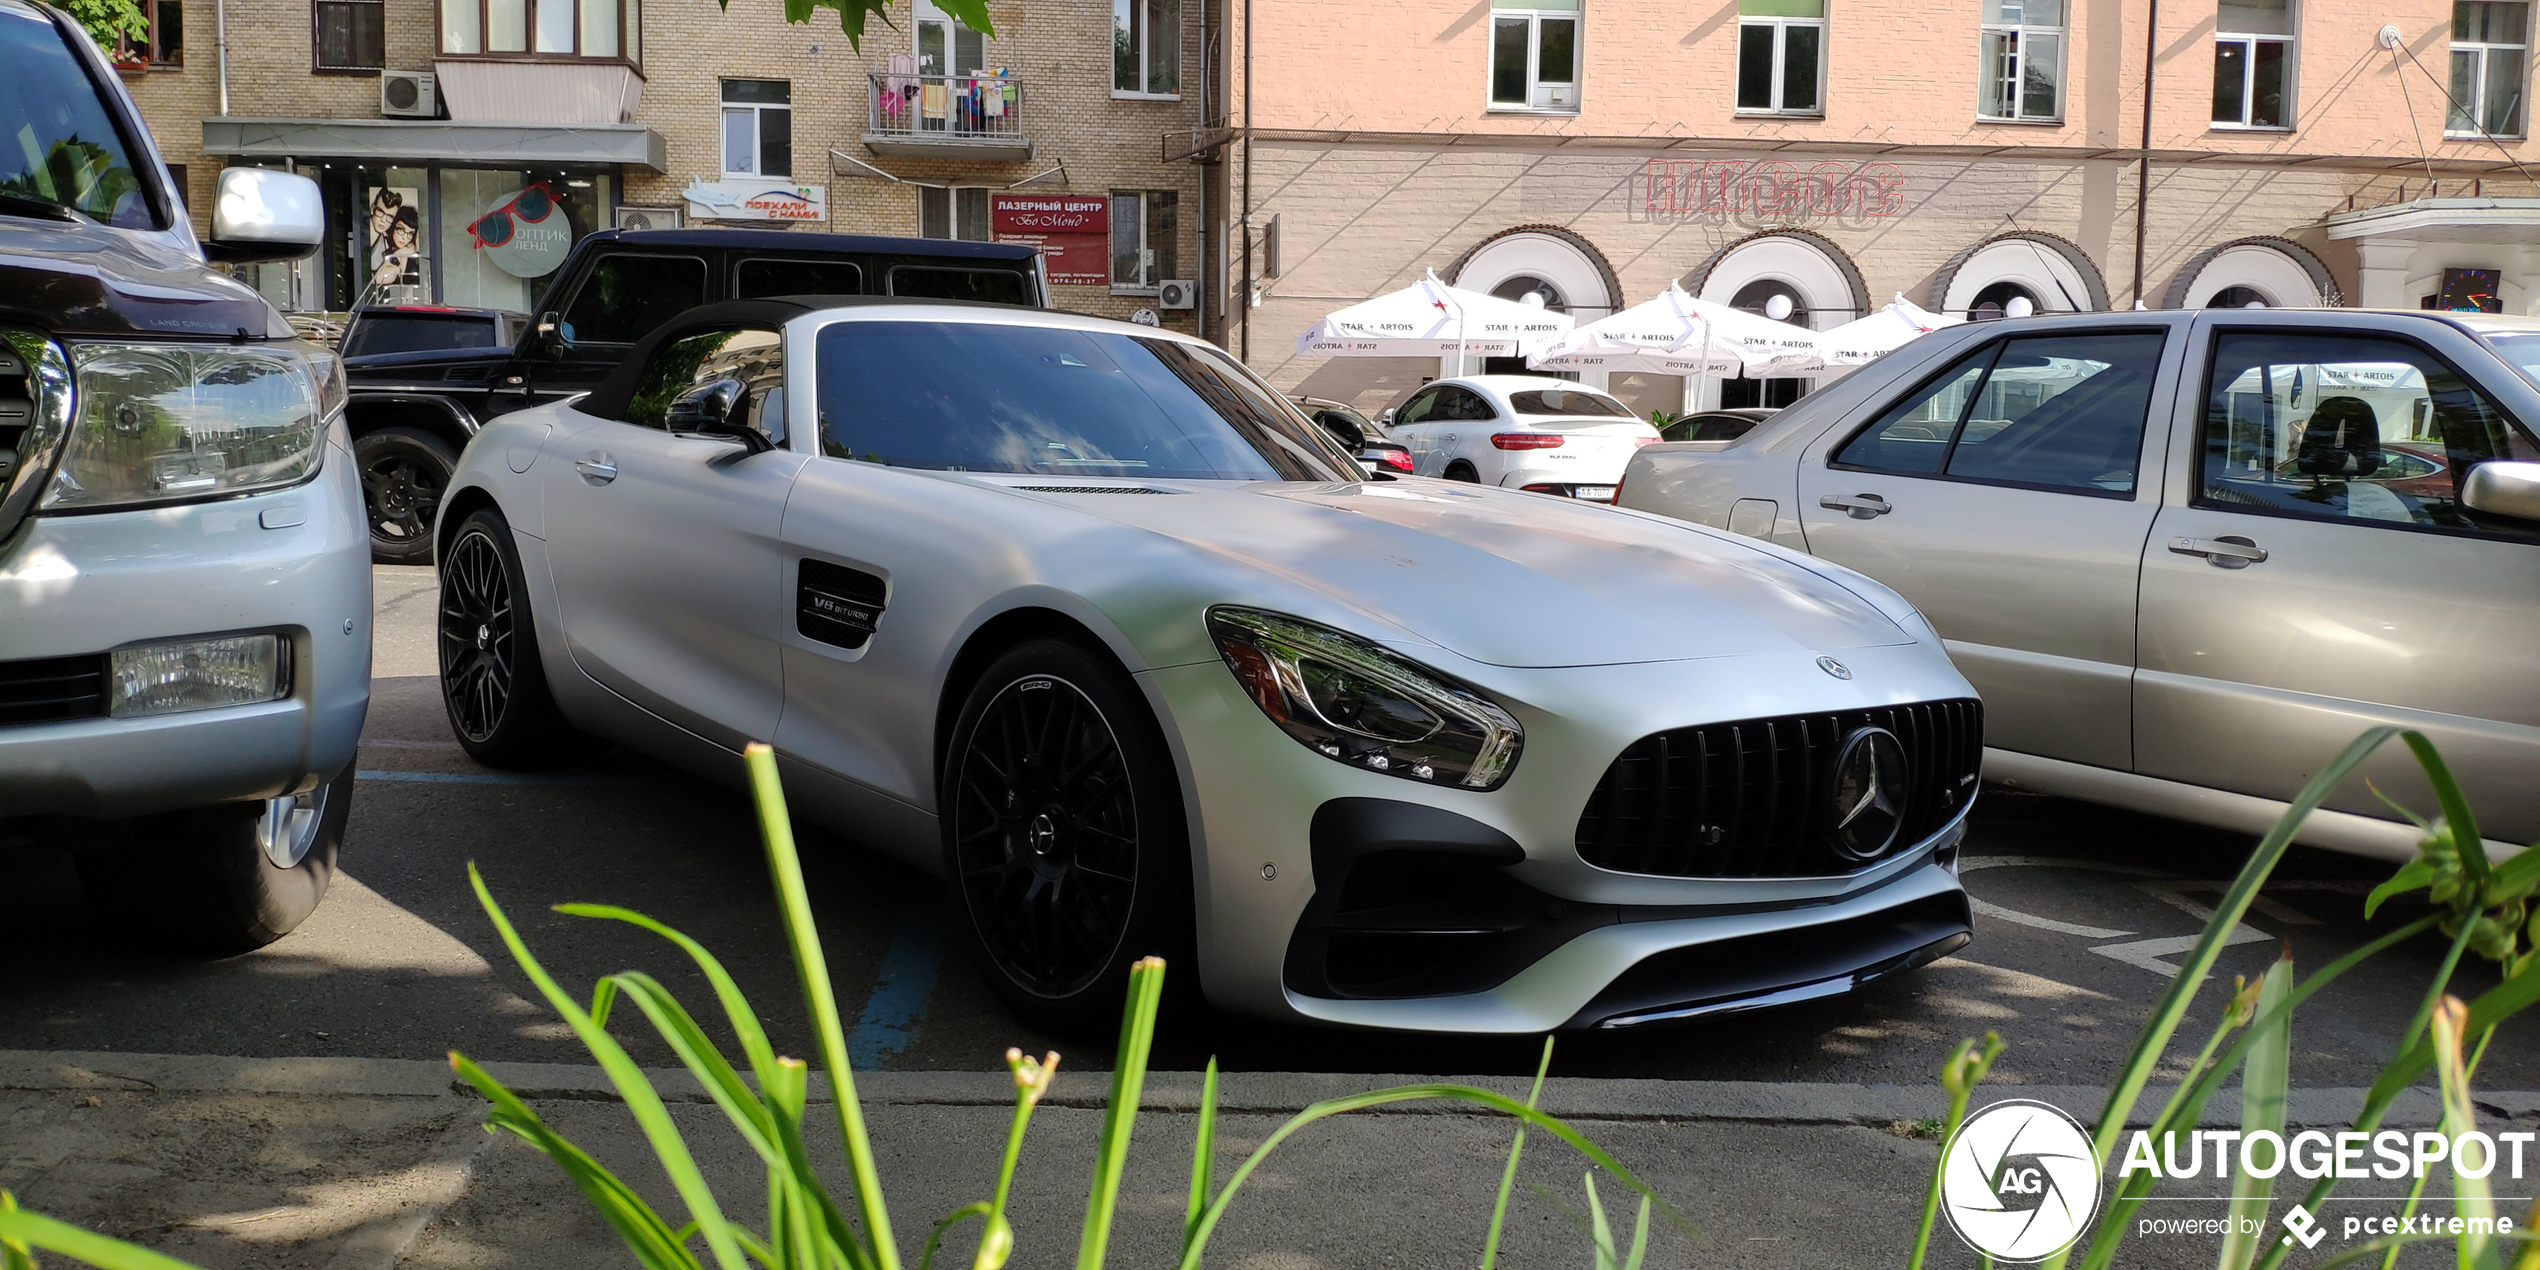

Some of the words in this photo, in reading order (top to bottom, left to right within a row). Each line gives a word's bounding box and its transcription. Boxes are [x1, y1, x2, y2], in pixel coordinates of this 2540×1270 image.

[745, 200, 808, 210] ПОЕХАЛИ
[997, 200, 1062, 211] ЛАЗЕРНЫЙ
[1064, 202, 1103, 213] ЦЕНТР
[768, 210, 778, 218] С
[1015, 213, 1039, 226] Бо
[1040, 213, 1083, 227] Монд
[514, 228, 568, 242] ОПТИК
[514, 241, 549, 253] ЛЕНД
[149, 319, 180, 327] LAND
[1341, 323, 1364, 331] STAR
[1379, 323, 1414, 331] ARTOIS
[1485, 324, 1509, 332] STAR
[1523, 324, 1558, 332] ARTOIS
[1641, 334, 1675, 342] ARTOIS
[1743, 337, 1767, 346] STAR
[1780, 340, 1814, 349] ARTOIS
[1835, 350, 1858, 358] STAR
[2327, 371, 2350, 379] STAR
[2363, 372, 2395, 380] ARTOIS
[1593, 488, 1610, 497] 7077
[814, 597, 835, 611] V8
[834, 605, 869, 621] BITURBO
